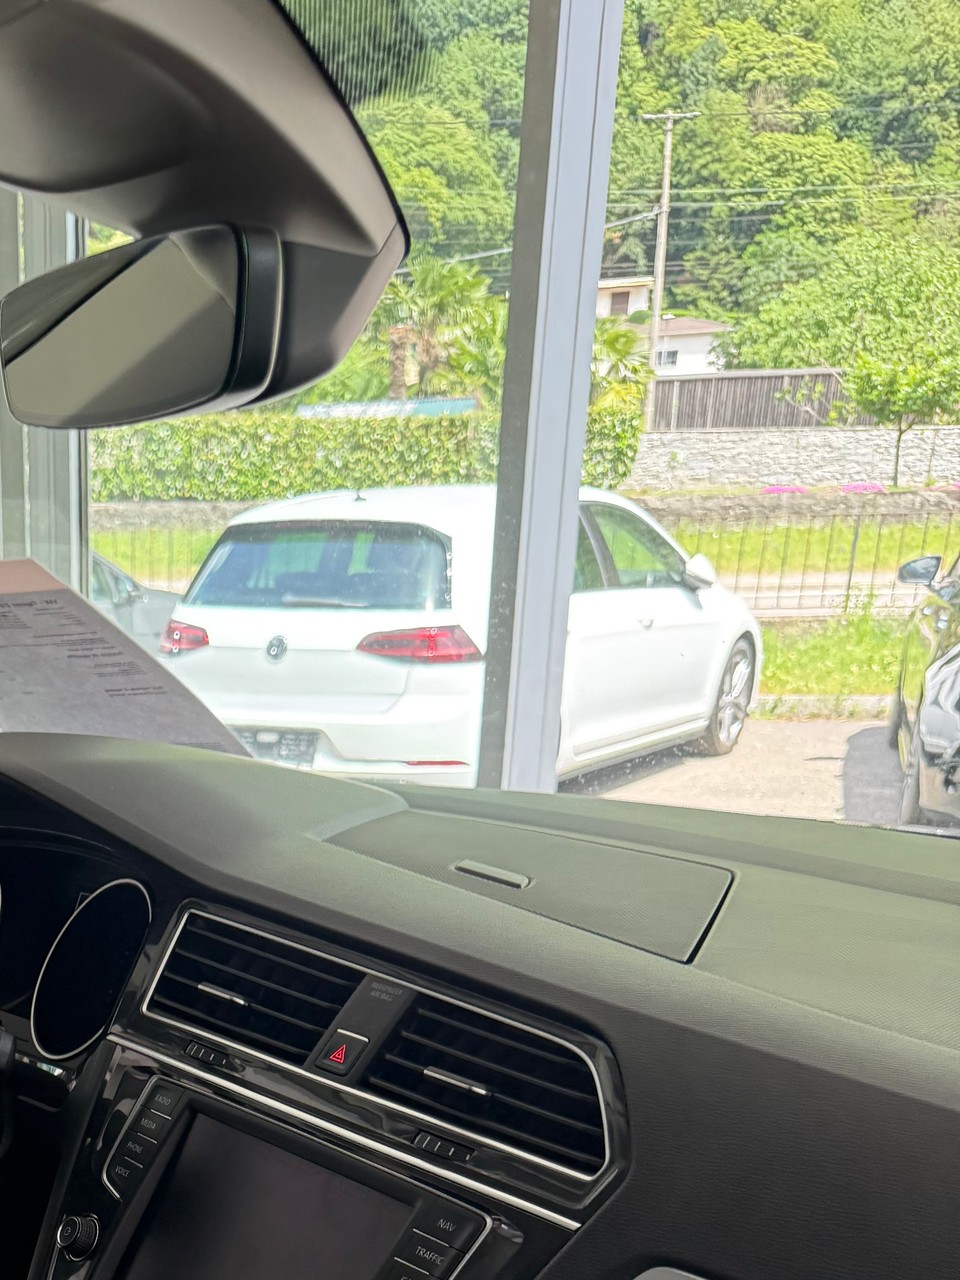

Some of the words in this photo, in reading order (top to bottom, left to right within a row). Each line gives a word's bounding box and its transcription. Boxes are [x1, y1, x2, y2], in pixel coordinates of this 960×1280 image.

[154, 1094, 171, 1106] RADIO
[141, 1118, 157, 1130] MEDIA
[126, 1141, 144, 1154] PHONE
[115, 1165, 131, 1178] VOICE
[438, 1218, 456, 1232] NAV
[415, 1246, 445, 1265] TRAFFIC
